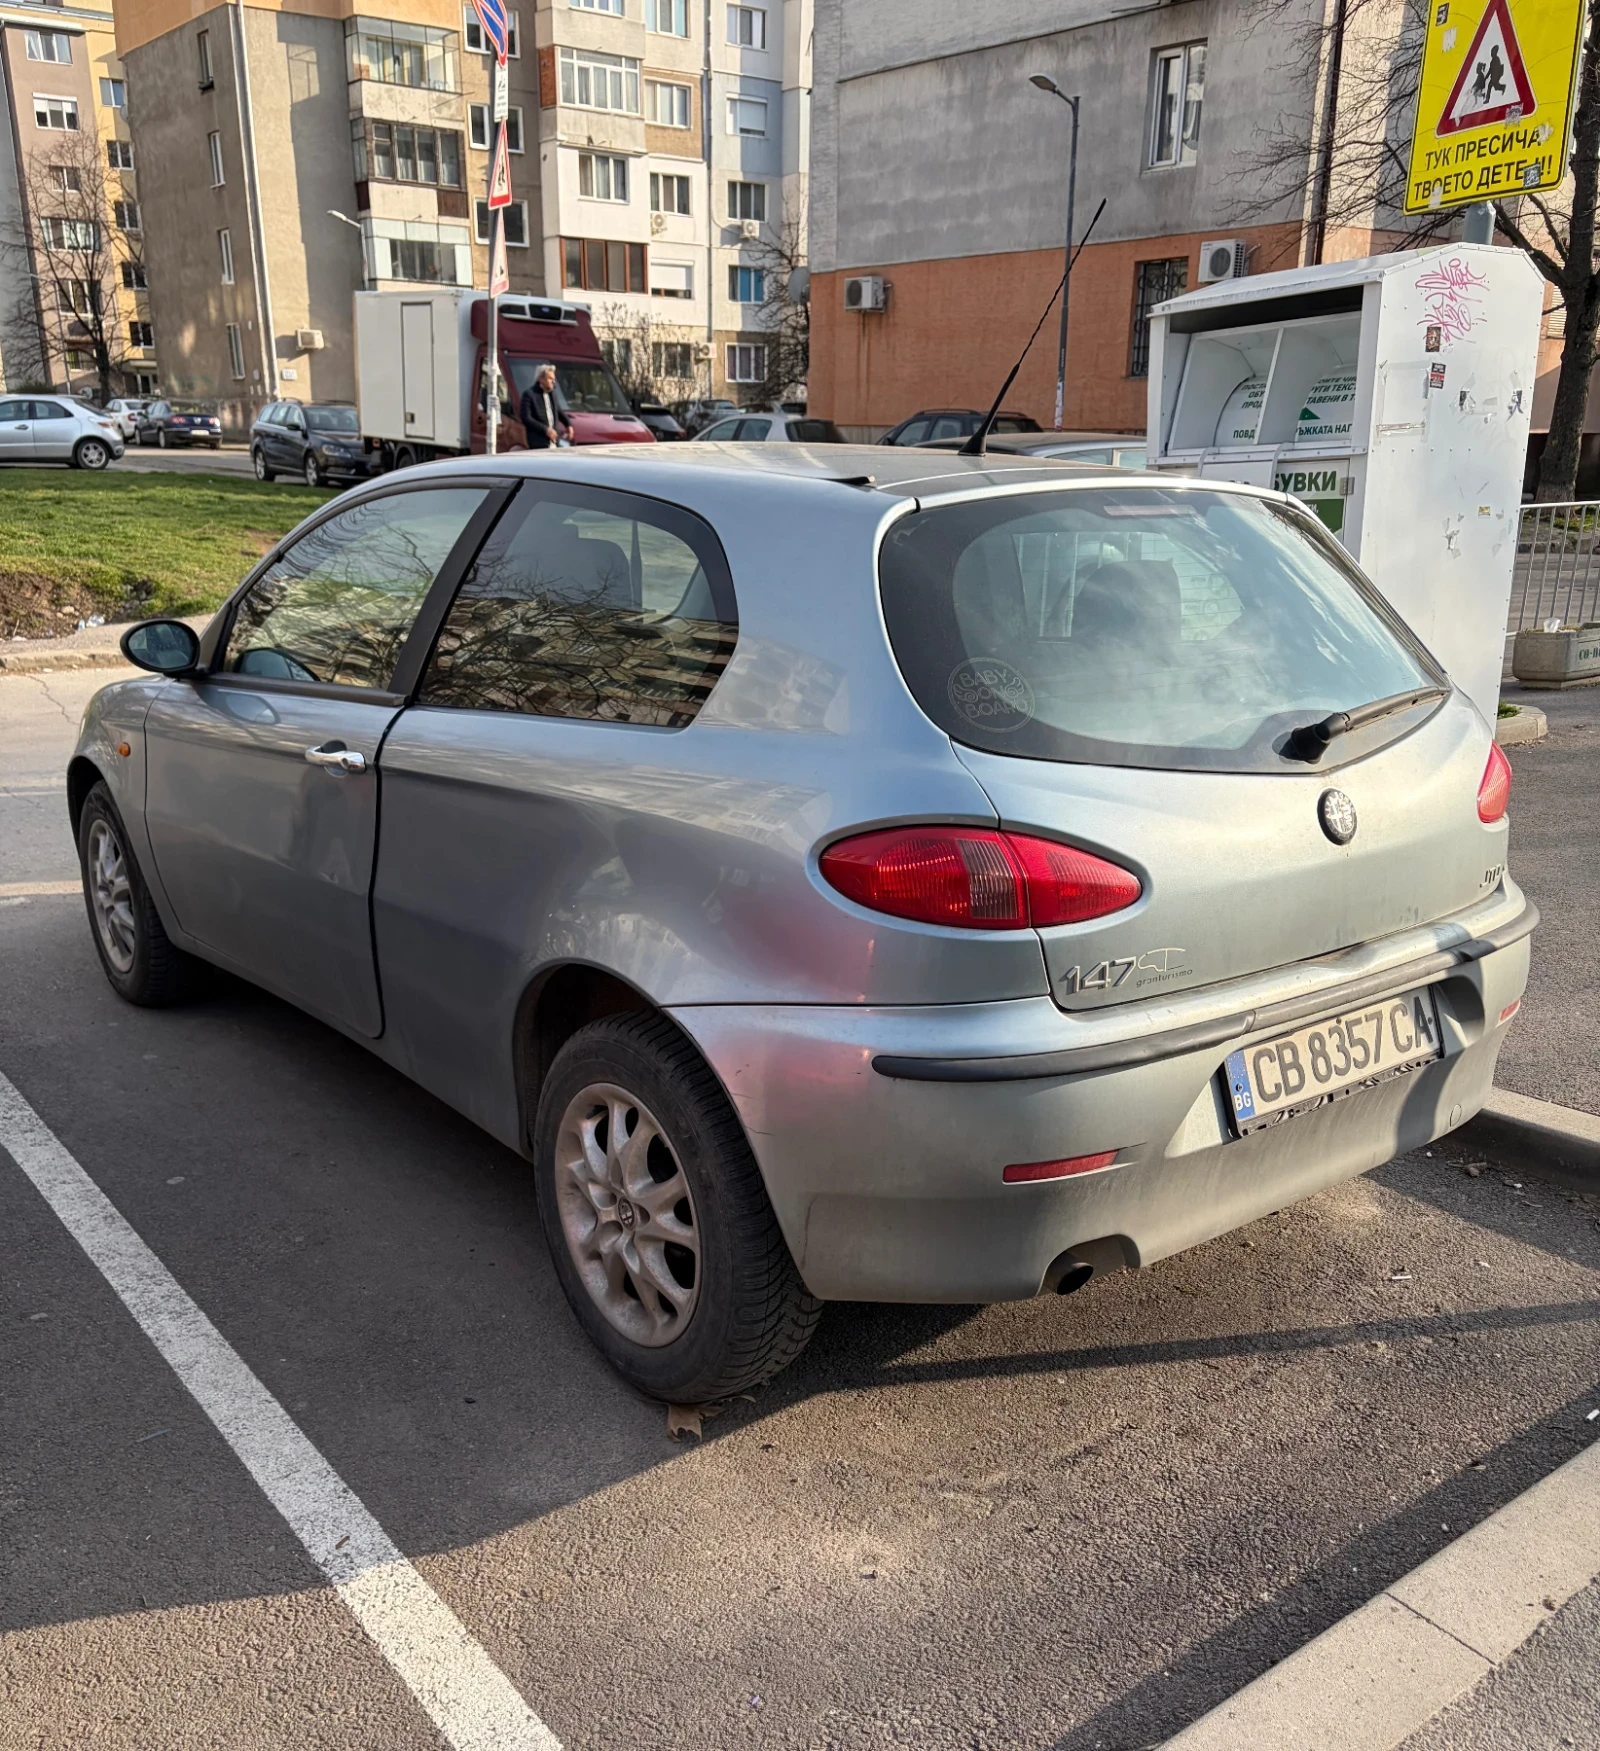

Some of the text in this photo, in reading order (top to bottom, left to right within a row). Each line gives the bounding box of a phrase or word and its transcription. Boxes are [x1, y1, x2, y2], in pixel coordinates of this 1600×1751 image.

[1426, 129, 1541, 171] ТУК ПРЕСИЧА
[1414, 170, 1473, 201] ТВОЕТО
[1476, 160, 1528, 191] ДЕТЕ
[1296, 424, 1334, 436] ЪЖКАТА
[959, 668, 1008, 688] BABY
[978, 685, 1007, 700] ON
[965, 699, 1029, 719] BOARD
[1058, 956, 1137, 996] 147
[1136, 969, 1194, 989] granturismo
[1252, 996, 1434, 1103] CB 8357 CA
[1234, 1091, 1251, 1112] BG
